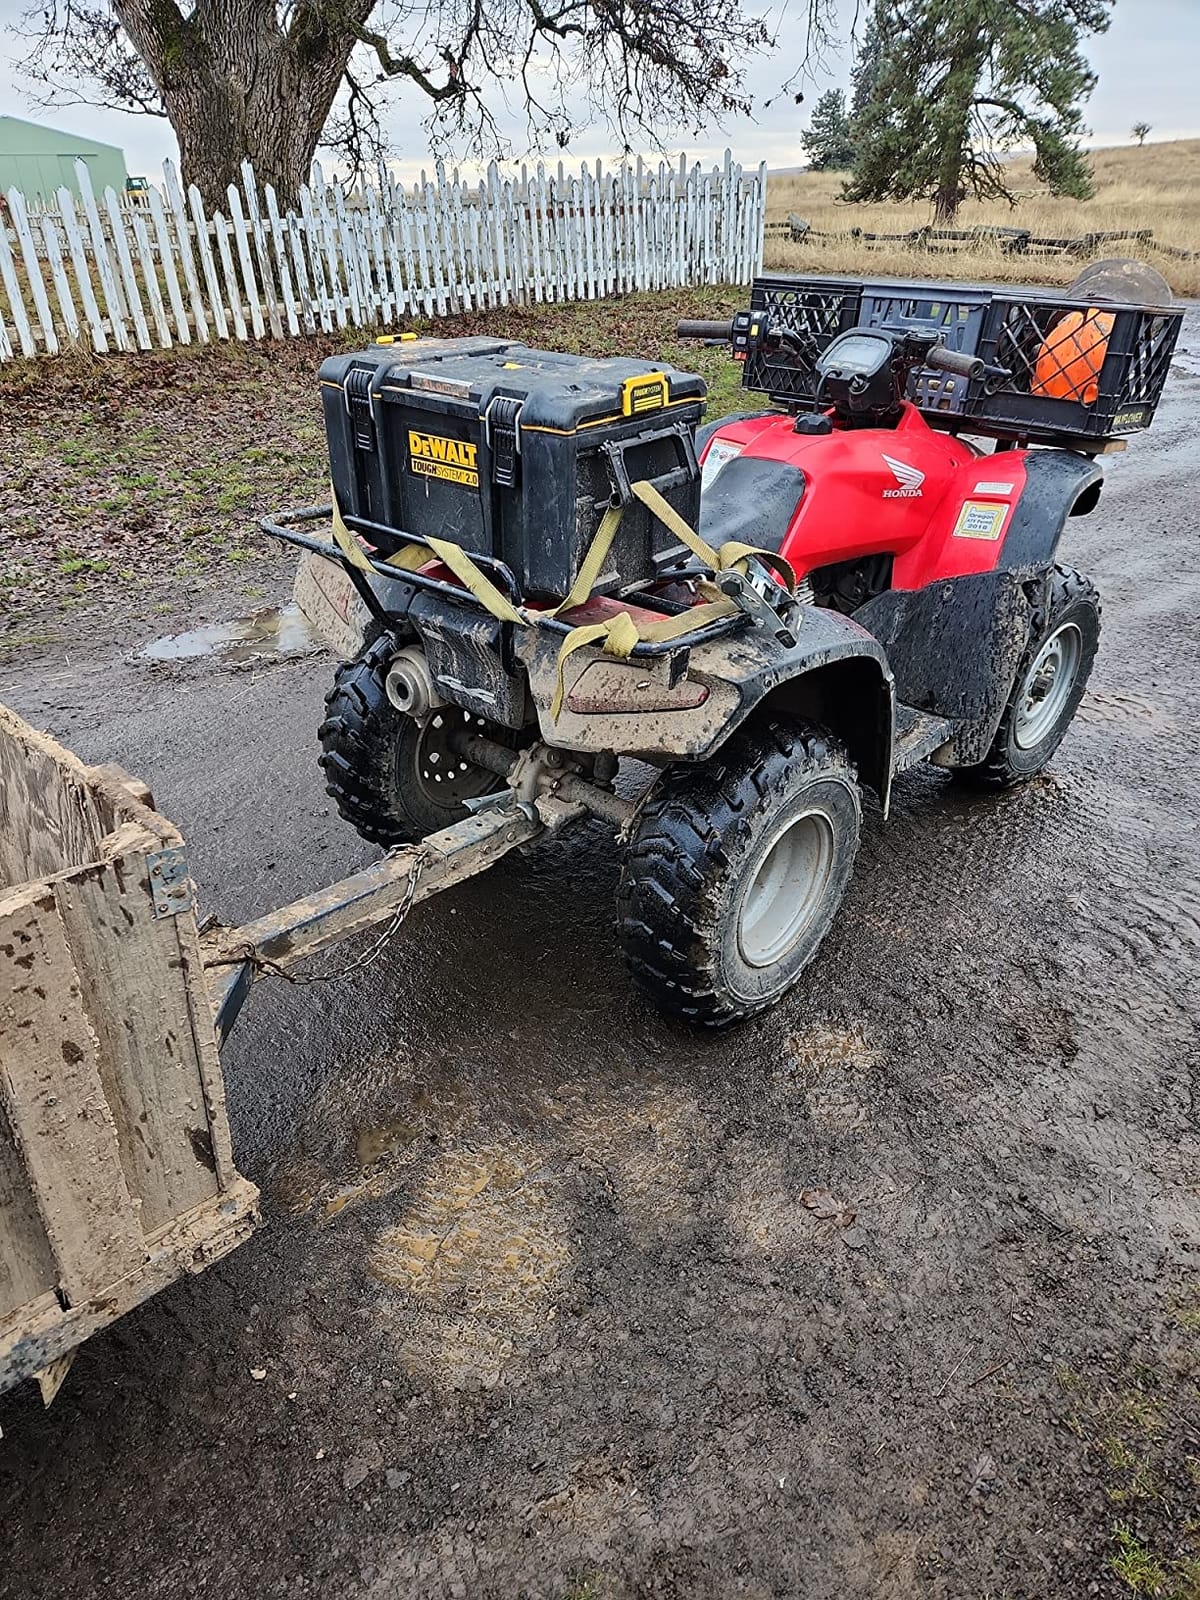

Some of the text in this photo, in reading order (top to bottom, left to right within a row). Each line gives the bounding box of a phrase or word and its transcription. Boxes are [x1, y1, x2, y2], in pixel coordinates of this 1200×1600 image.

[409, 432, 477, 467] DEWALT
[465, 472, 478, 485] 2.0
[882, 489, 923, 498] HONDA
